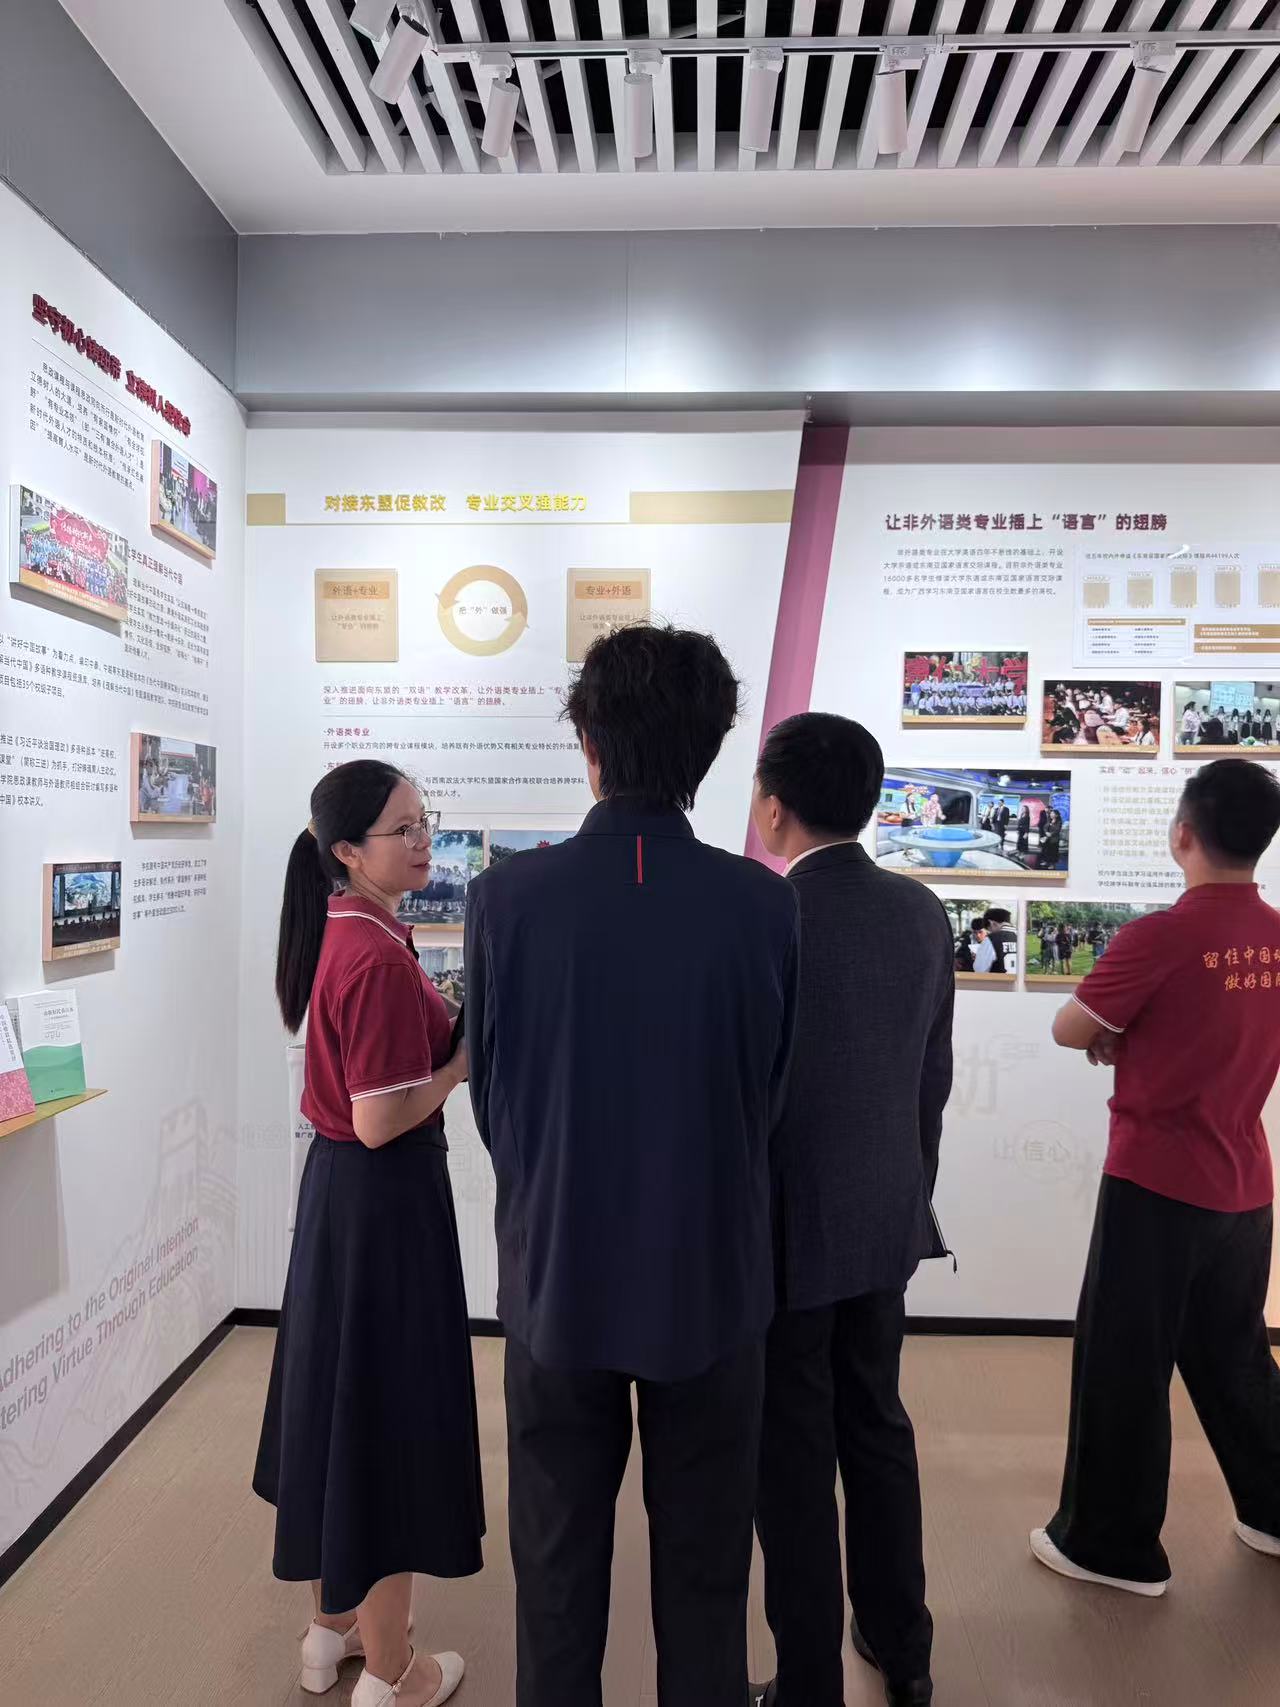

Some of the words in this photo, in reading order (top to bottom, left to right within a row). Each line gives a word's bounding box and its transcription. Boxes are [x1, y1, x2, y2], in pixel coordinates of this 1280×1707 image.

[324, 494, 447, 512] 对接东盟促教改
[466, 493, 588, 511] 专业交叉强能力
[885, 513, 1168, 531] 让非外语类专业插上“语言”的翅膀
[332, 584, 378, 596] 外语+专业
[584, 584, 632, 596] 专业+外语
[69, 1311, 82, 1336] to
[85, 1291, 106, 1322] the
[109, 1248, 154, 1301] Original
[156, 1217, 200, 1264] Intention
[52, 1337, 94, 1384] Virtue
[96, 1288, 146, 1345] Through
[150, 1246, 199, 1299] Education
